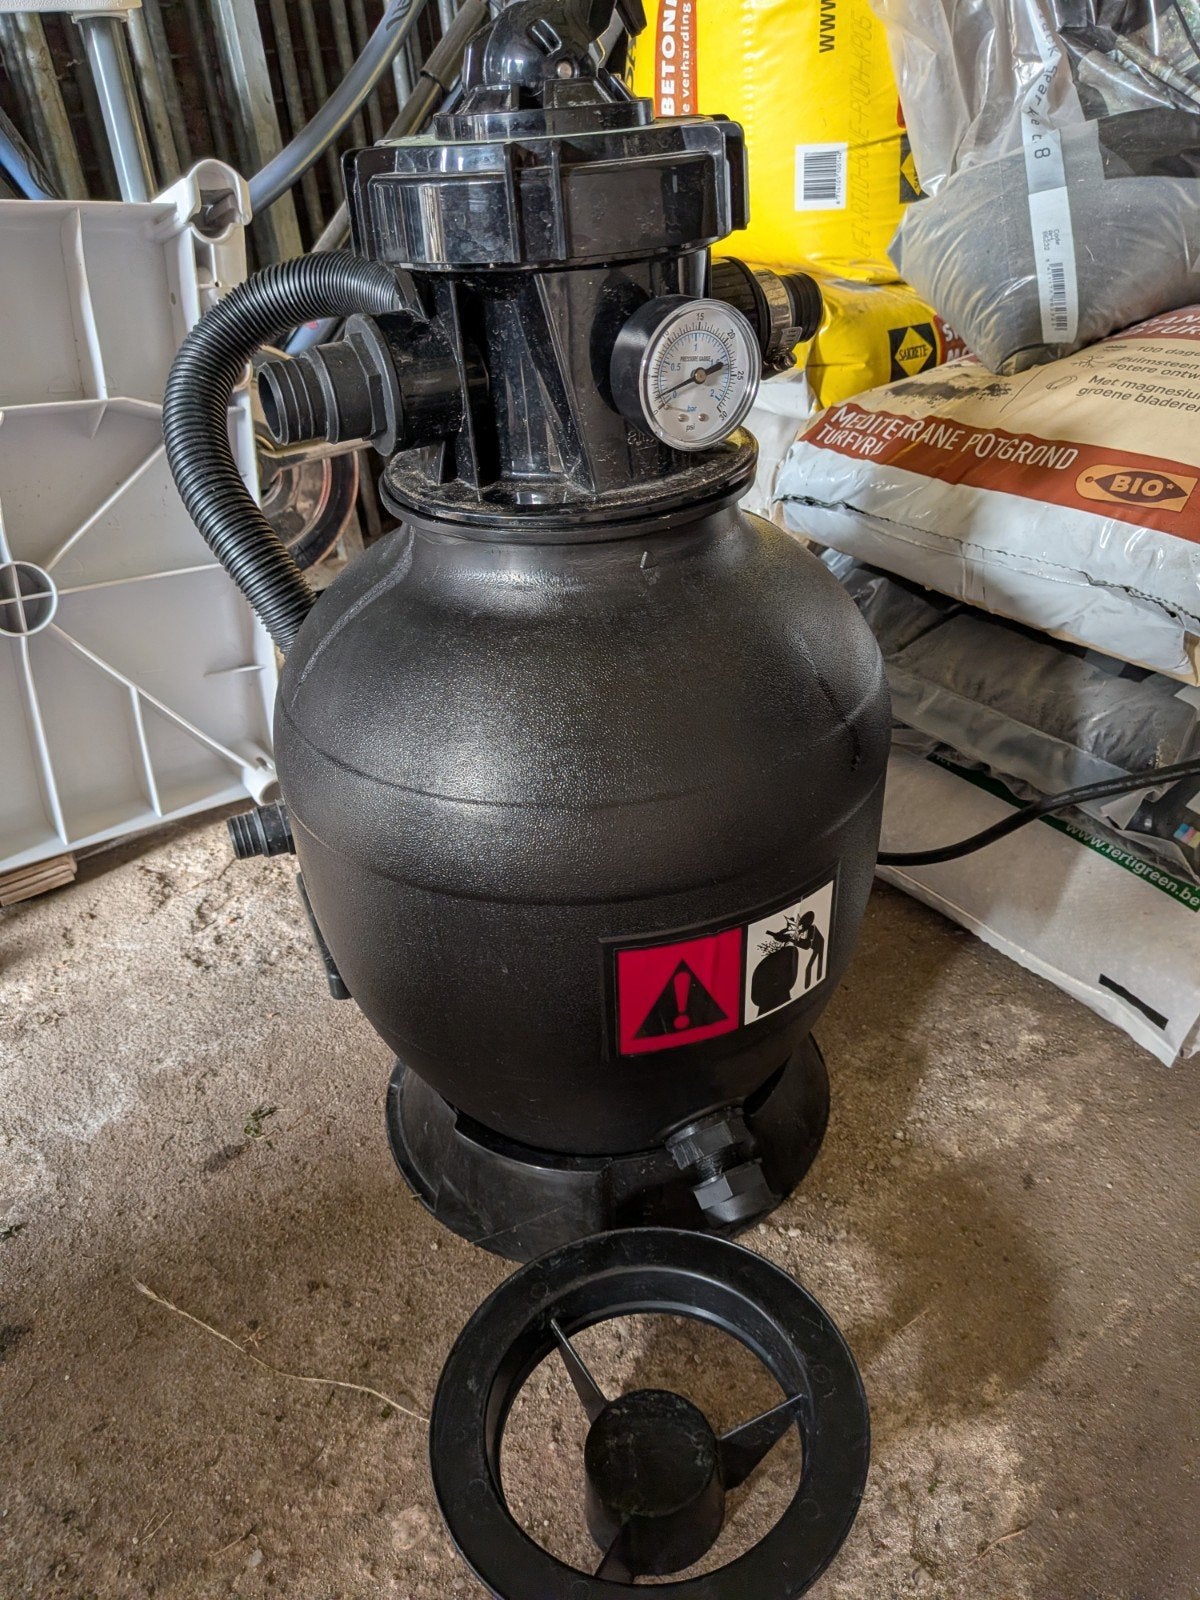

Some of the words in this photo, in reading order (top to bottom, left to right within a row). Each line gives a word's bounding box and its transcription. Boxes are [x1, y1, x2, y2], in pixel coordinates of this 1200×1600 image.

[681, 2, 692, 98] verharding
[1034, 147, 1051, 160] 8
[696, 312, 705, 320] 15
[727, 328, 736, 340] 20
[898, 344, 929, 361] SAKRETE
[670, 363, 681, 371] 0.5
[736, 370, 745, 381] 25
[1087, 374, 1120, 387] Met
[672, 390, 678, 398] 0
[710, 389, 715, 398] 2
[1076, 387, 1132, 401] groene
[686, 405, 698, 413] bar
[718, 411, 728, 421] 30
[685, 423, 696, 432] psi
[960, 433, 1079, 470] POTGROND
[1065, 823, 1200, 907] www.fertigreen.be
